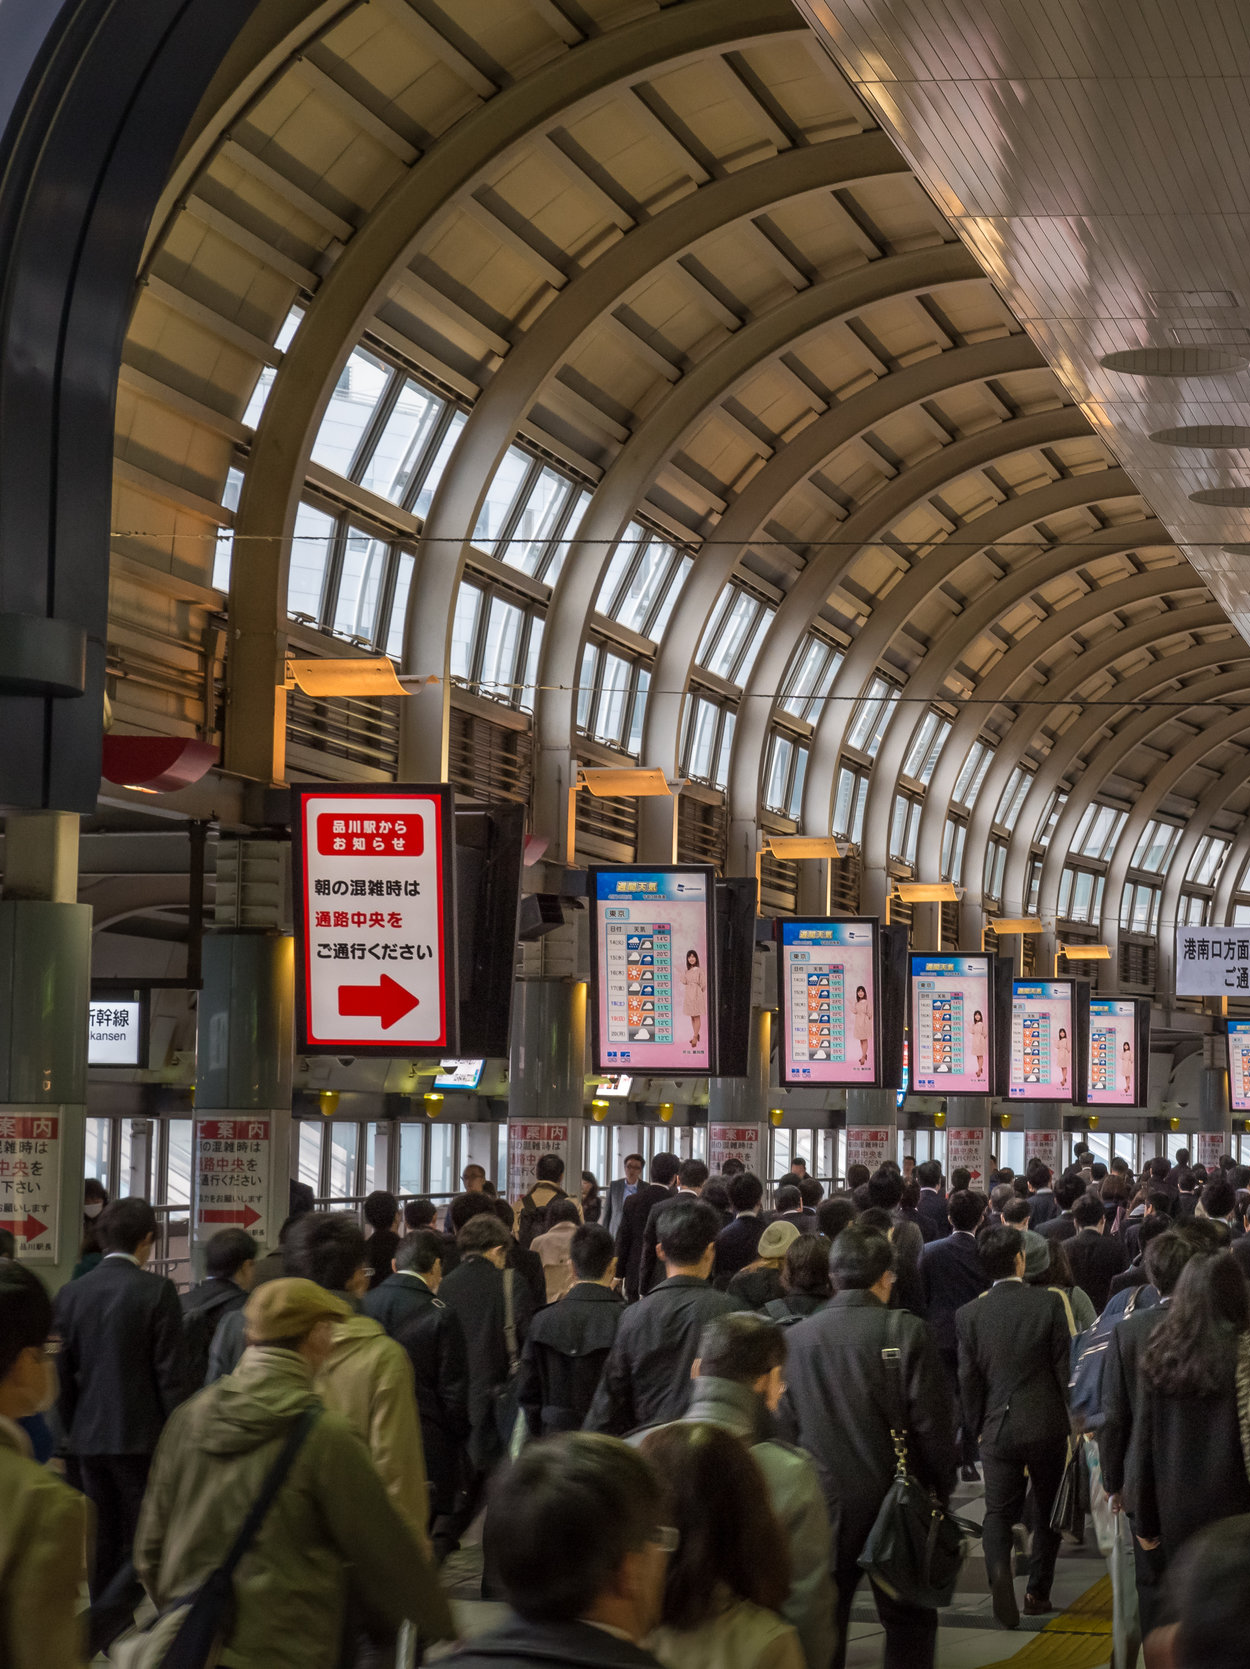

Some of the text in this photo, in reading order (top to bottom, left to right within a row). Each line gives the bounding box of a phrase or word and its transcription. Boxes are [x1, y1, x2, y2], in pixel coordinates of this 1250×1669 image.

[333, 820, 407, 834] 品川駅から
[333, 837, 406, 851] お知らせ
[315, 879, 420, 897] 朝の混雑時は
[315, 911, 403, 928] 通路中央を
[316, 943, 433, 960] ご通行ください
[0, 1141, 48, 1154] 雑時は
[200, 1141, 262, 1153] の混雑時は
